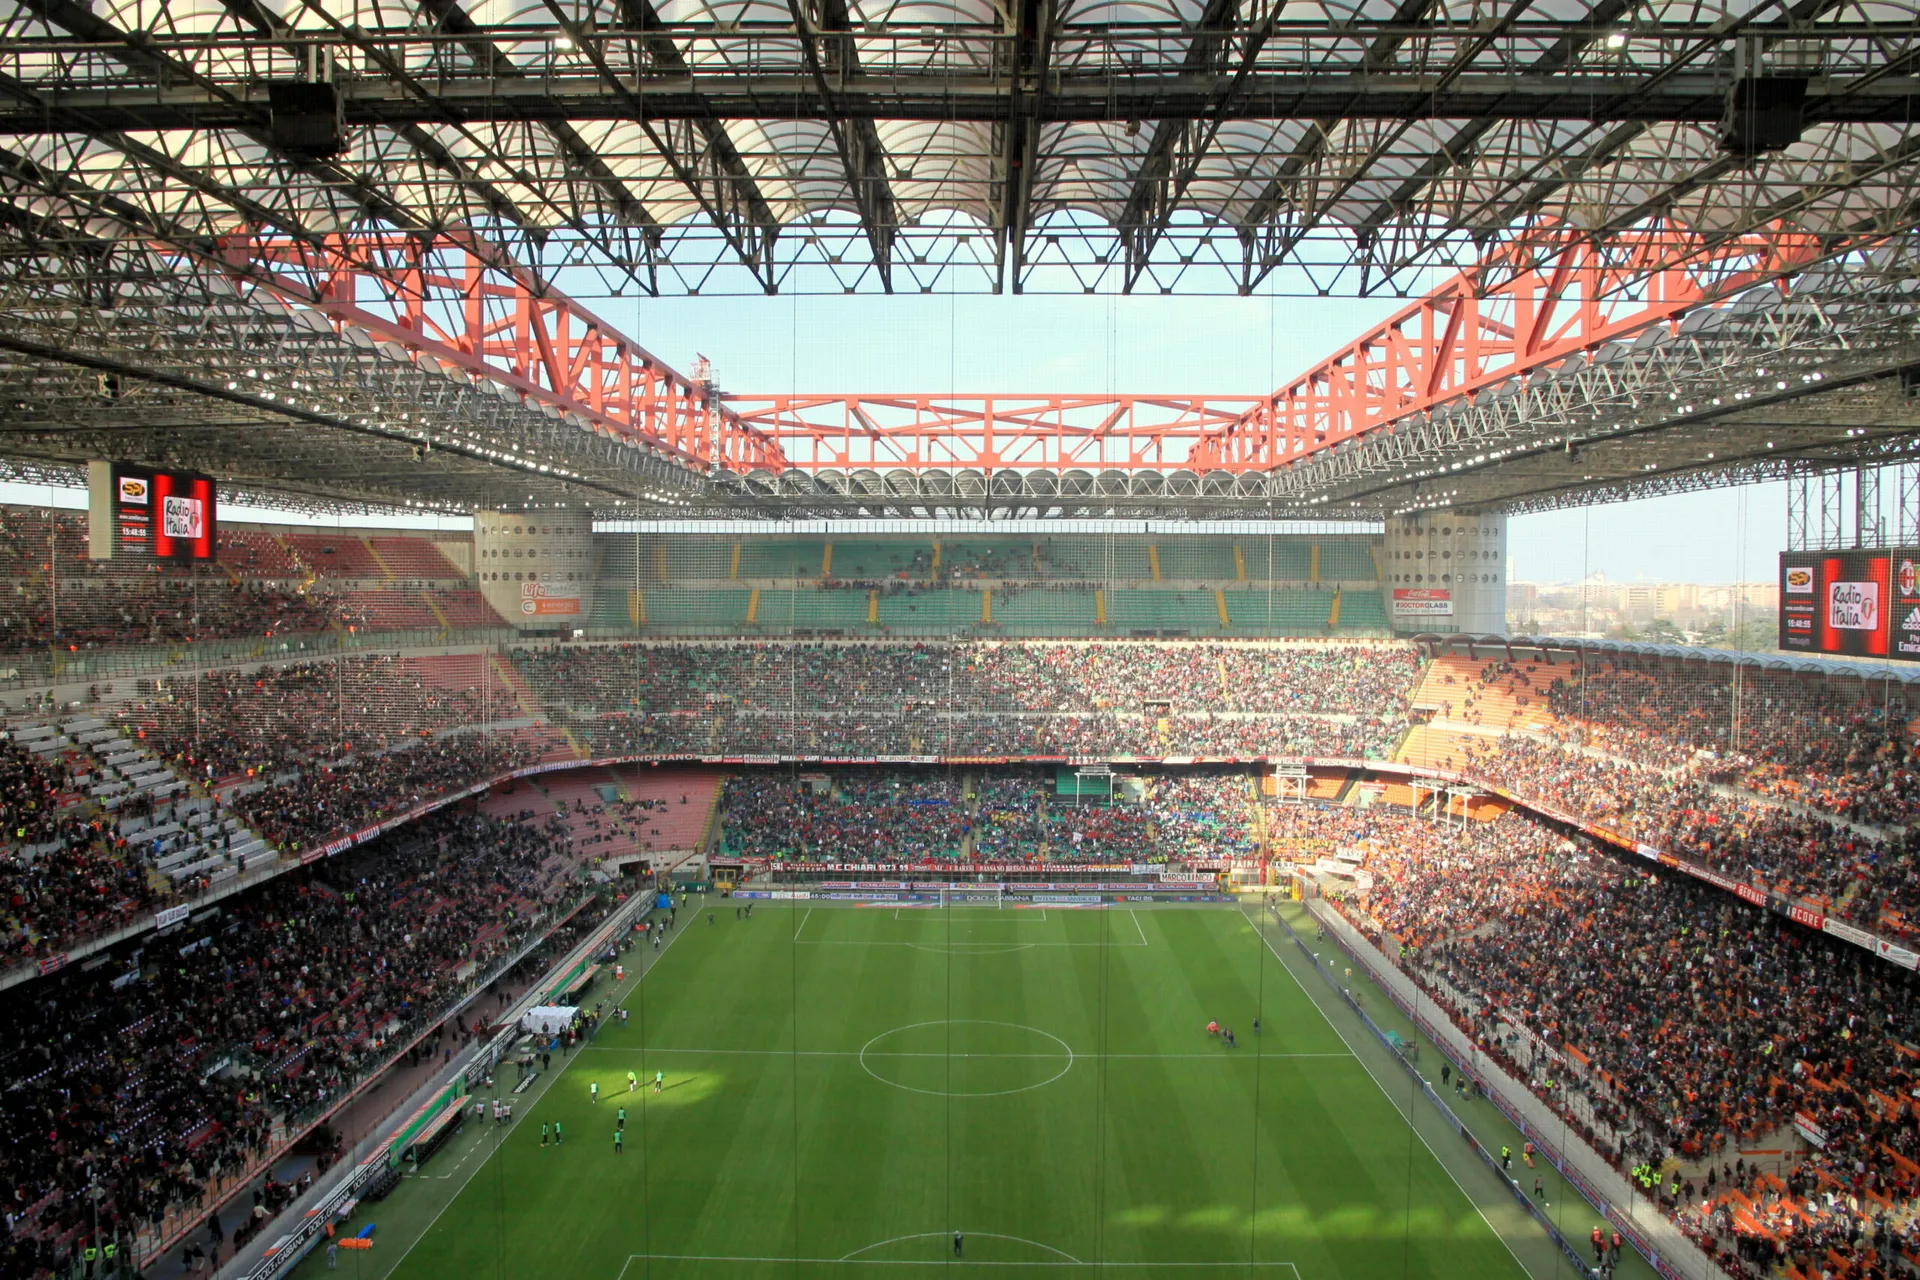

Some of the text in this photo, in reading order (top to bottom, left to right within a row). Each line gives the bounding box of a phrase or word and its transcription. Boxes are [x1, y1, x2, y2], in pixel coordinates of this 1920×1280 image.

[166, 500, 190, 516] Radio
[166, 516, 189, 535] Italia
[1832, 585, 1861, 604] Radio
[1832, 606, 1861, 626] Italia
[622, 753, 693, 763] LANDRIANO
[844, 863, 876, 872] CHIARI
[1231, 860, 1259, 869] PAINA
[1162, 873, 1186, 881] MARCO
[1738, 885, 1768, 907] BERNATE
[1786, 905, 1819, 927] ARCORE
[353, 1173, 367, 1192] DOLCE
[368, 1151, 390, 1176] GABBANA
[308, 1215, 325, 1236] DOLCE
[326, 1190, 351, 1218] GABBANA
[276, 1234, 305, 1265] GABBANA
